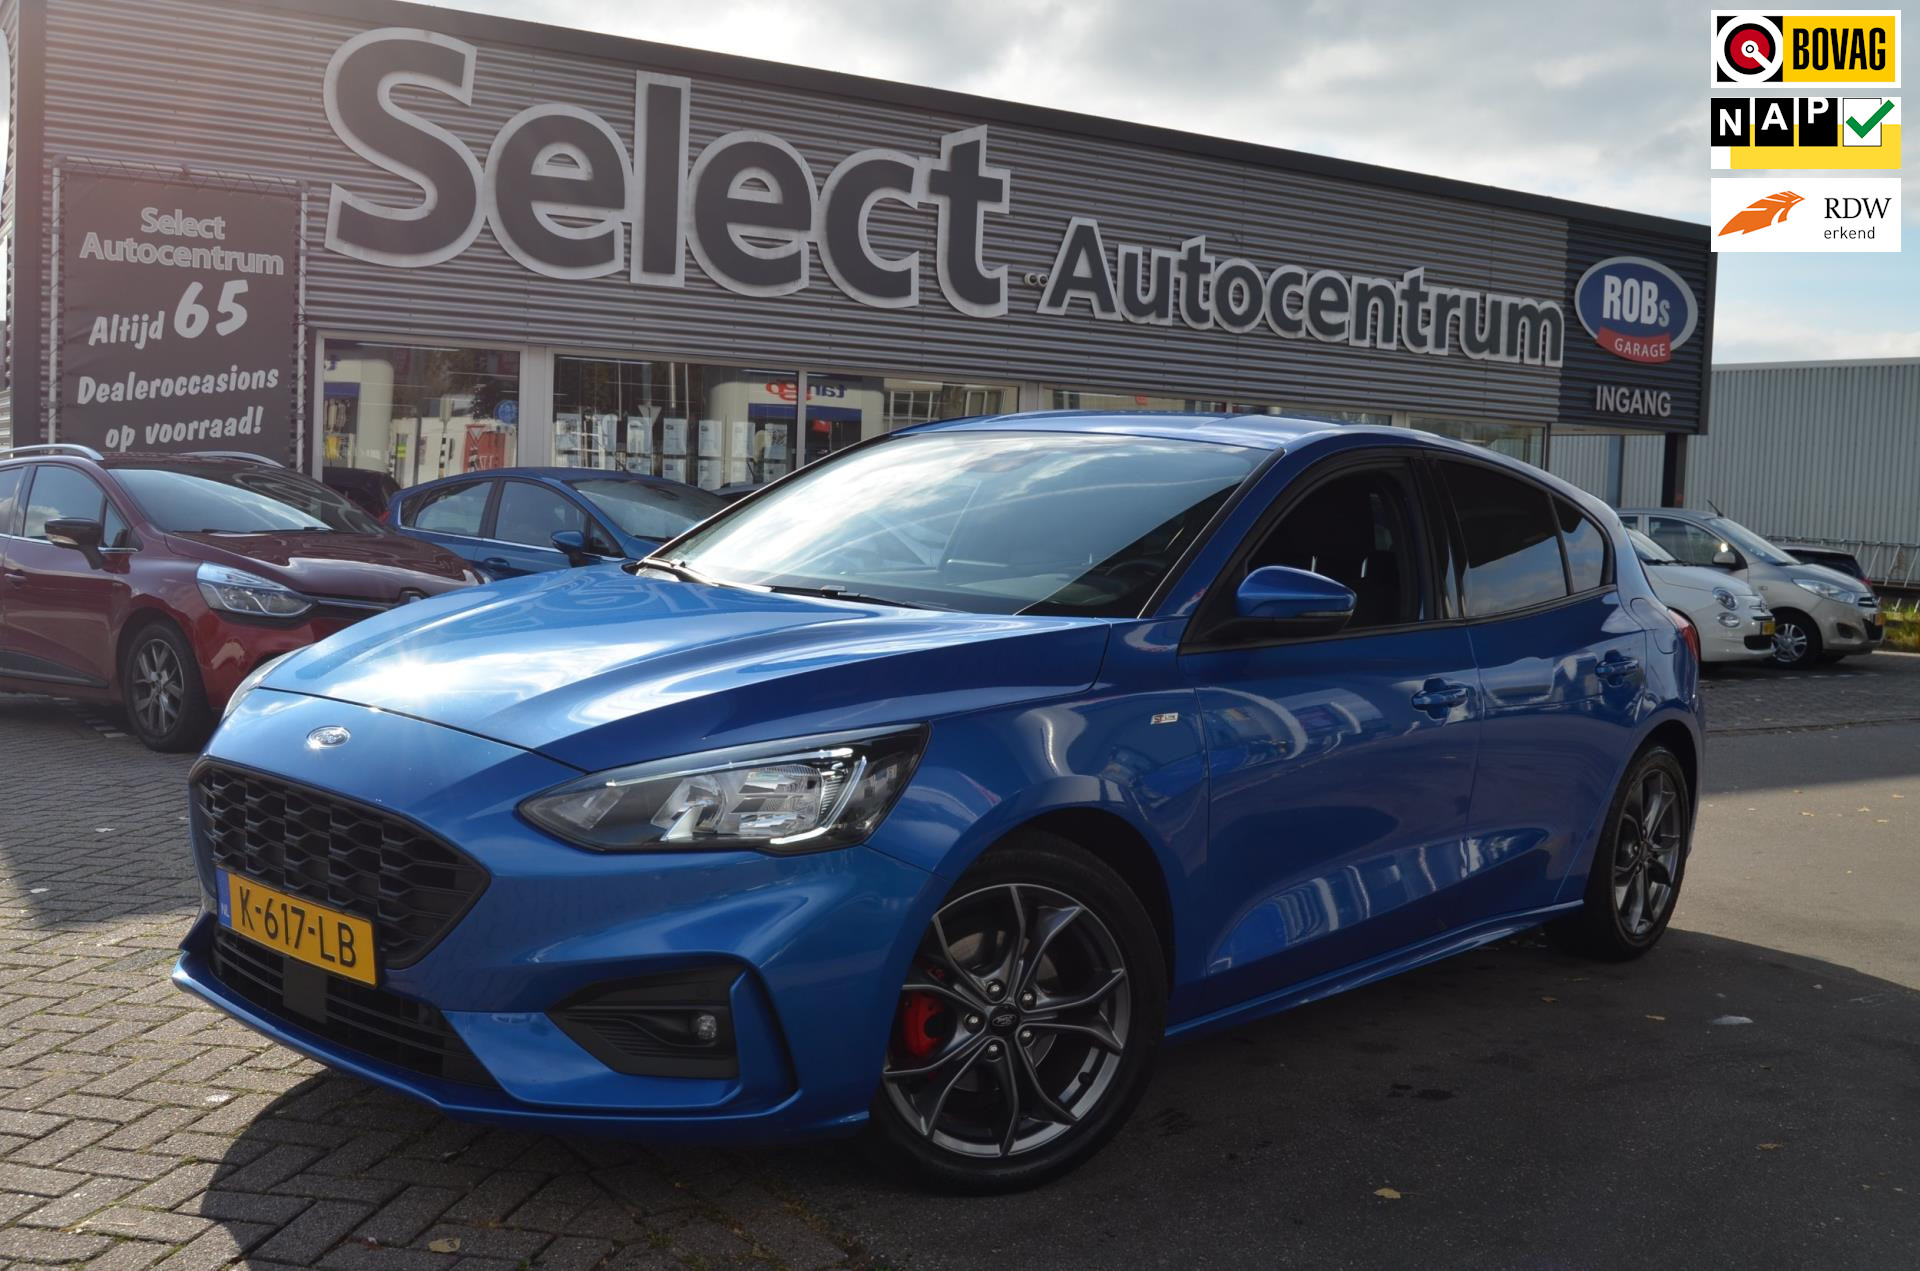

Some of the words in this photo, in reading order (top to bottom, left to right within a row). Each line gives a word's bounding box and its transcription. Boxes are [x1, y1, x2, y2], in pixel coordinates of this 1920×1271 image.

[323, 27, 1010, 318] Select
[1036, 216, 1565, 368] Autocentrum
[140, 206, 226, 240] Select
[79, 231, 284, 276] Autocentrum
[88, 310, 166, 350] Altijd
[173, 279, 249, 339] 65
[1602, 274, 1671, 328] ROBs
[1613, 337, 1667, 358] GARAGE
[76, 364, 279, 405] Dealeroccasions
[1595, 384, 1672, 417] INGANG
[105, 424, 136, 453] op
[145, 405, 264, 445] voorraad!
[239, 885, 357, 969] K-617-LB
